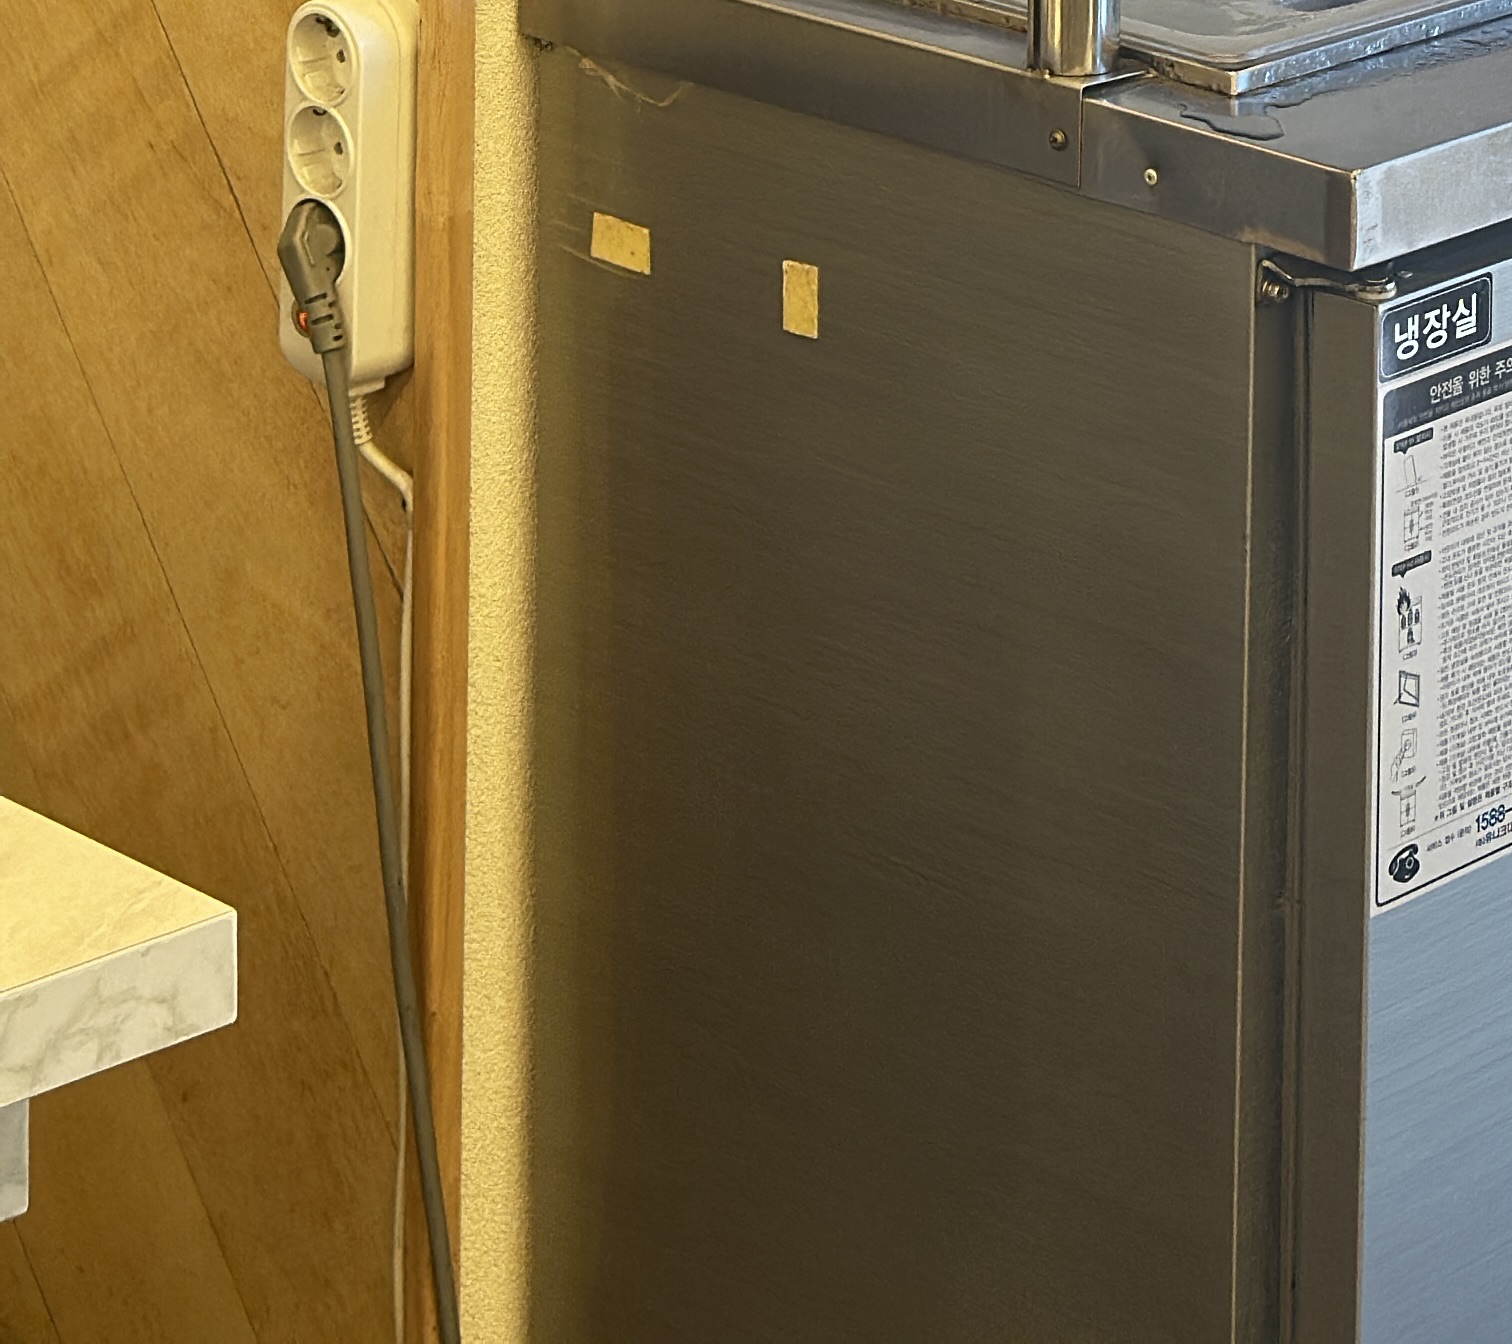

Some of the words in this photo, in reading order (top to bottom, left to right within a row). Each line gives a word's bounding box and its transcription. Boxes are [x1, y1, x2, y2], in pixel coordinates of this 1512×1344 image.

[1394, 293, 1477, 359] 냉장실
[1430, 375, 1463, 403] 안전을
[1469, 365, 1490, 389] 위한
